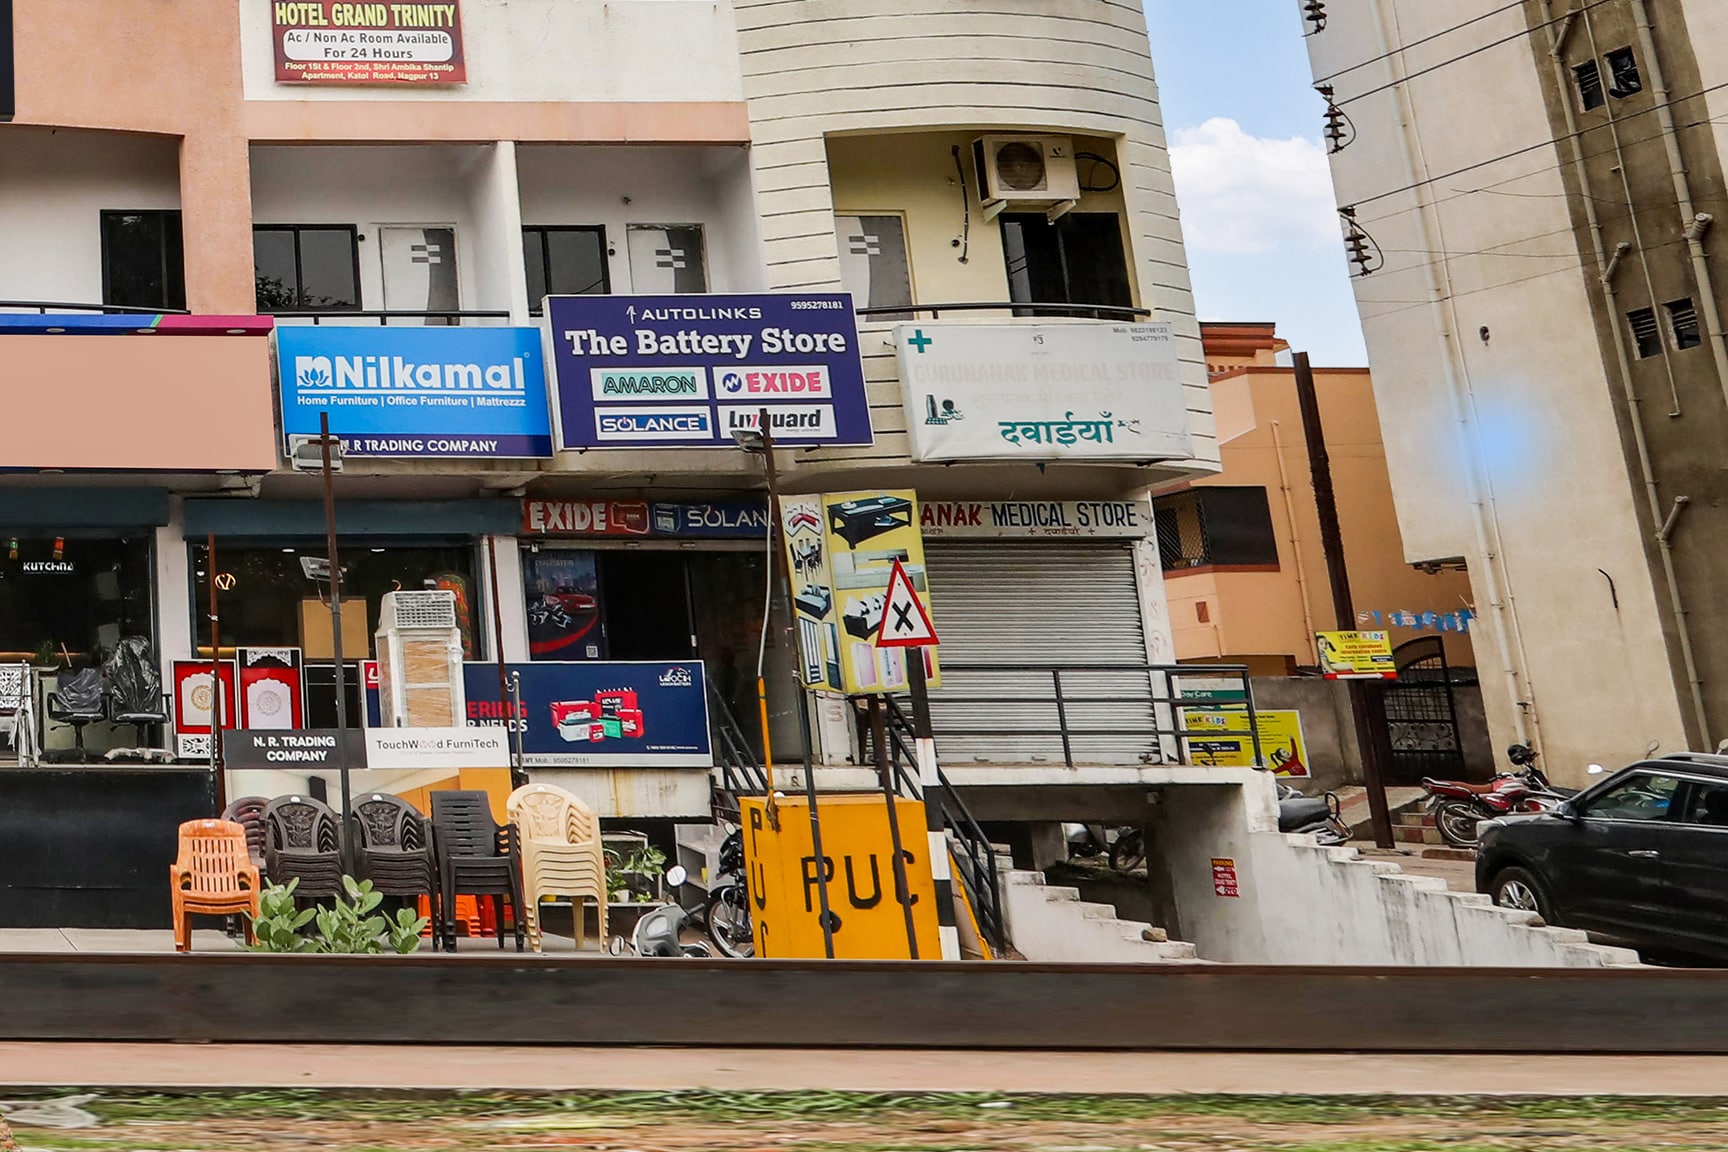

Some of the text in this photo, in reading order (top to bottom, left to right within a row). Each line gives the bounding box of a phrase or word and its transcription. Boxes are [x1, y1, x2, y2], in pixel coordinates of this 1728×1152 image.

[275, 2, 456, 27] HOTEL GRAND TRINITY
[287, 32, 302, 43] Ac
[314, 33, 337, 43] Non
[340, 33, 355, 43] Ac
[359, 33, 393, 44] Room
[397, 33, 448, 44] Available
[324, 48, 413, 59] For 24 Hours
[642, 307, 761, 320] AUTOLINKS
[790, 301, 843, 310] 9595278181
[565, 327, 846, 359] The Battery Store
[334, 356, 525, 389] Nilkamal
[603, 375, 696, 393] AMARON
[746, 371, 821, 392] EXIDE
[297, 396, 526, 406] Home Furniture Office Furniture Mattrezzz
[602, 415, 700, 432] SOLANCE
[998, 411, 1114, 447] दवाईयाँ
[354, 440, 362, 451] R
[365, 440, 424, 452] TRADING
[427, 440, 497, 452] COMPANY
[529, 501, 607, 531] EXIDE
[990, 503, 1071, 526] MEDICAL
[1076, 503, 1138, 527] STORE
[253, 736, 335, 747] N. R. TRADING
[446, 739, 499, 749] FurniTech
[266, 751, 327, 762] COMPANY
[801, 850, 919, 912] PUC
